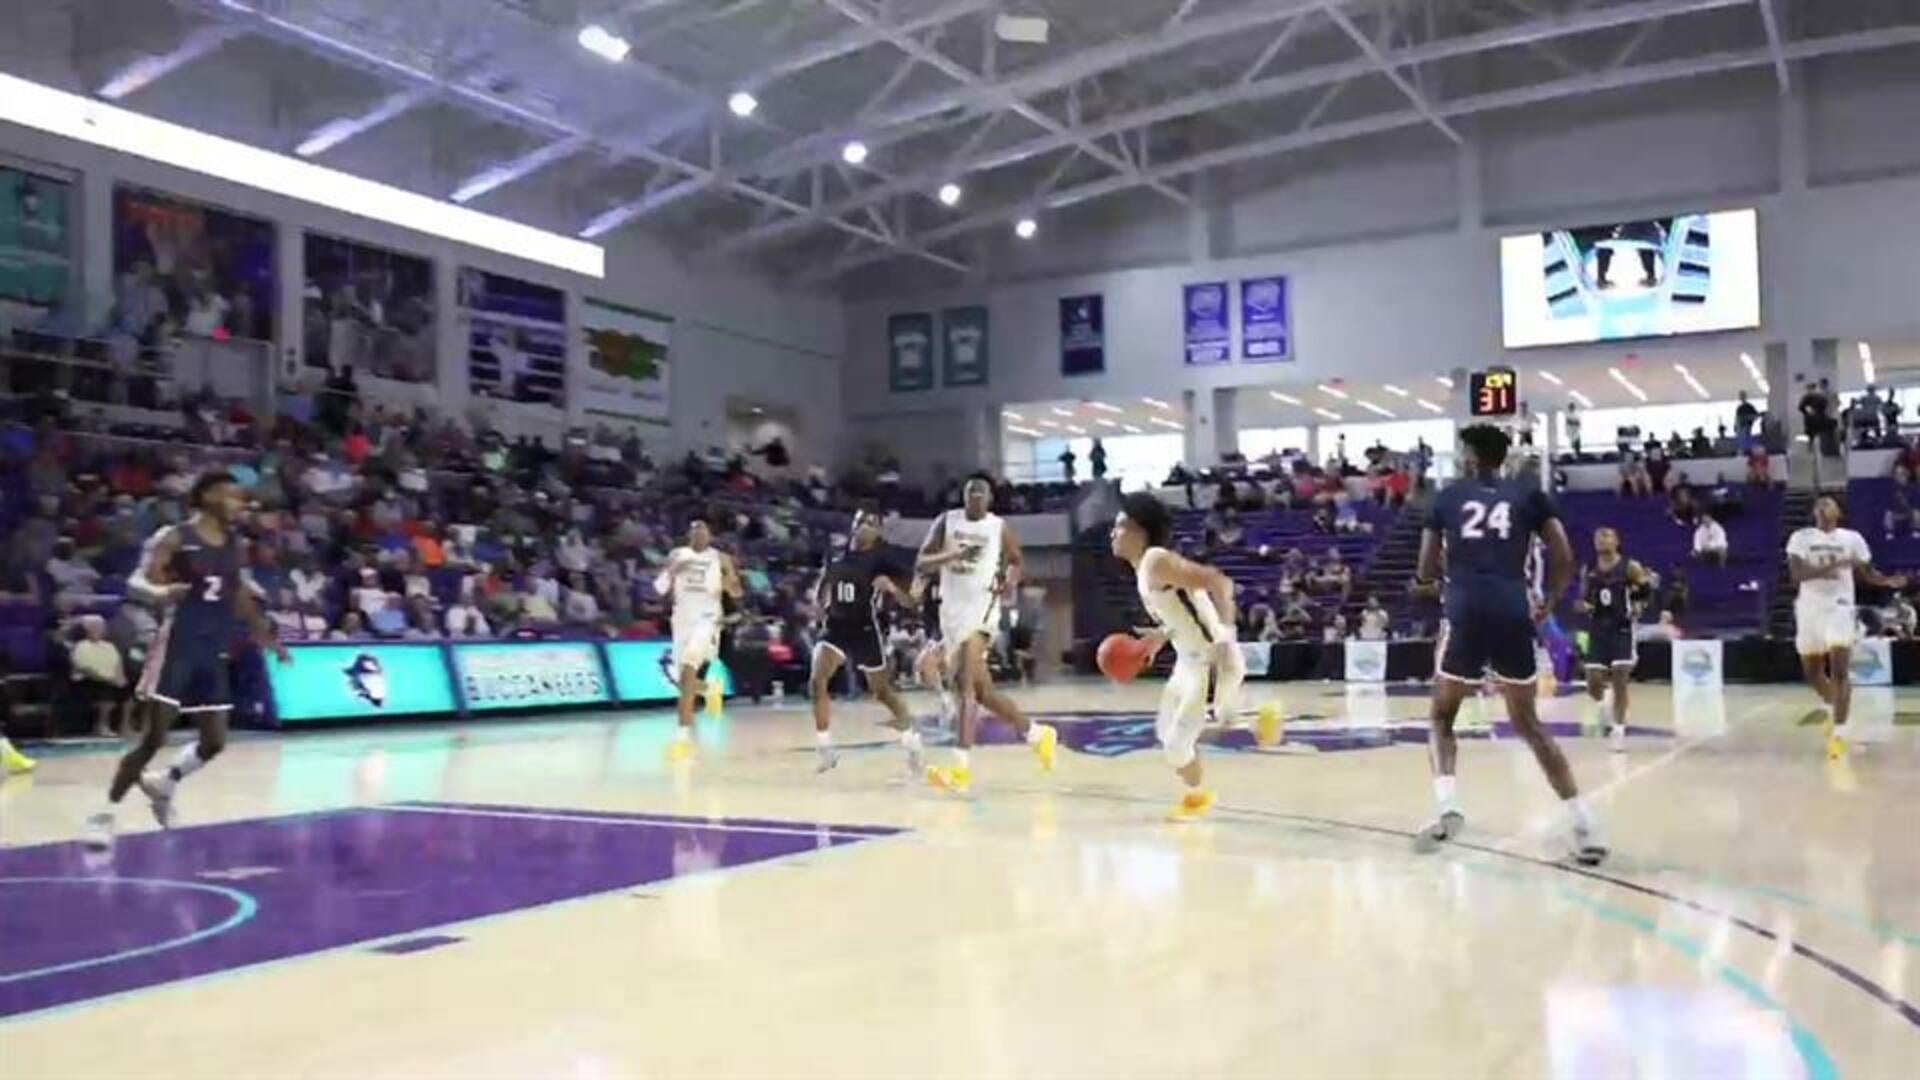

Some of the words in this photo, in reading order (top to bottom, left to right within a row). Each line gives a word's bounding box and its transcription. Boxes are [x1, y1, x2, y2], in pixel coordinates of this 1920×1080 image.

[1480, 388, 1507, 410] 31
[1461, 501, 1512, 539] 24
[203, 576, 222, 601] 2
[837, 581, 855, 602] 10
[1600, 588, 1611, 606] 0
